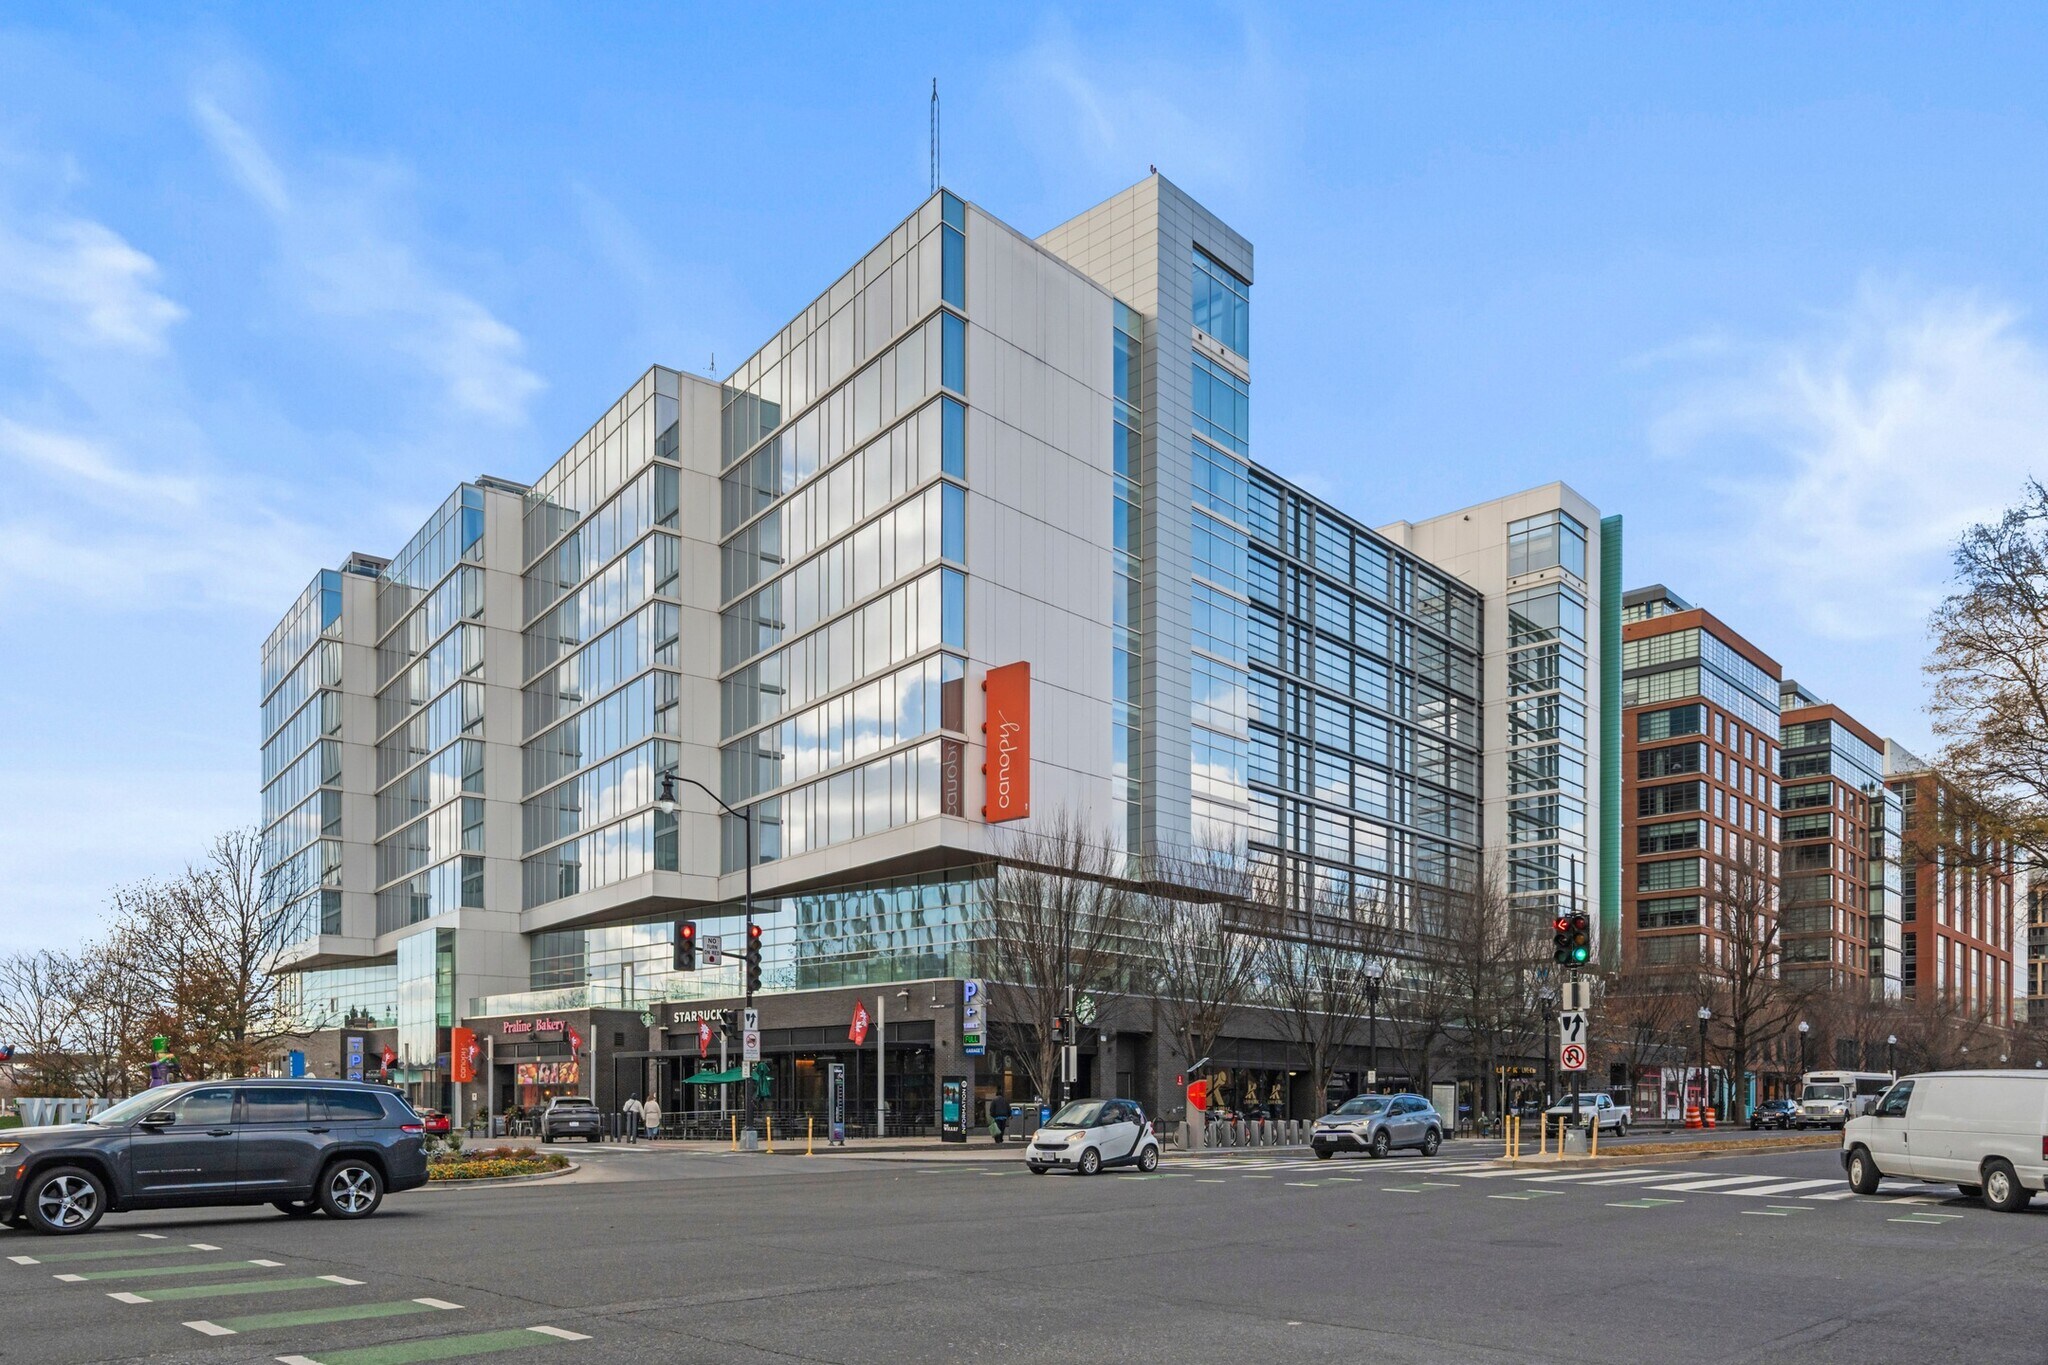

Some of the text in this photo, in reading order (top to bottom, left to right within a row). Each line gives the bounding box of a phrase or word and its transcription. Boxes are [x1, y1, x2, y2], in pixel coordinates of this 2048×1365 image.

[998, 710, 1020, 809] canopy
[965, 982, 978, 1002] P
[673, 1008, 728, 1023] STARBUCK
[502, 1017, 566, 1034] Praline Bakery
[964, 1035, 979, 1043] FULL
[351, 1054, 361, 1067] P
